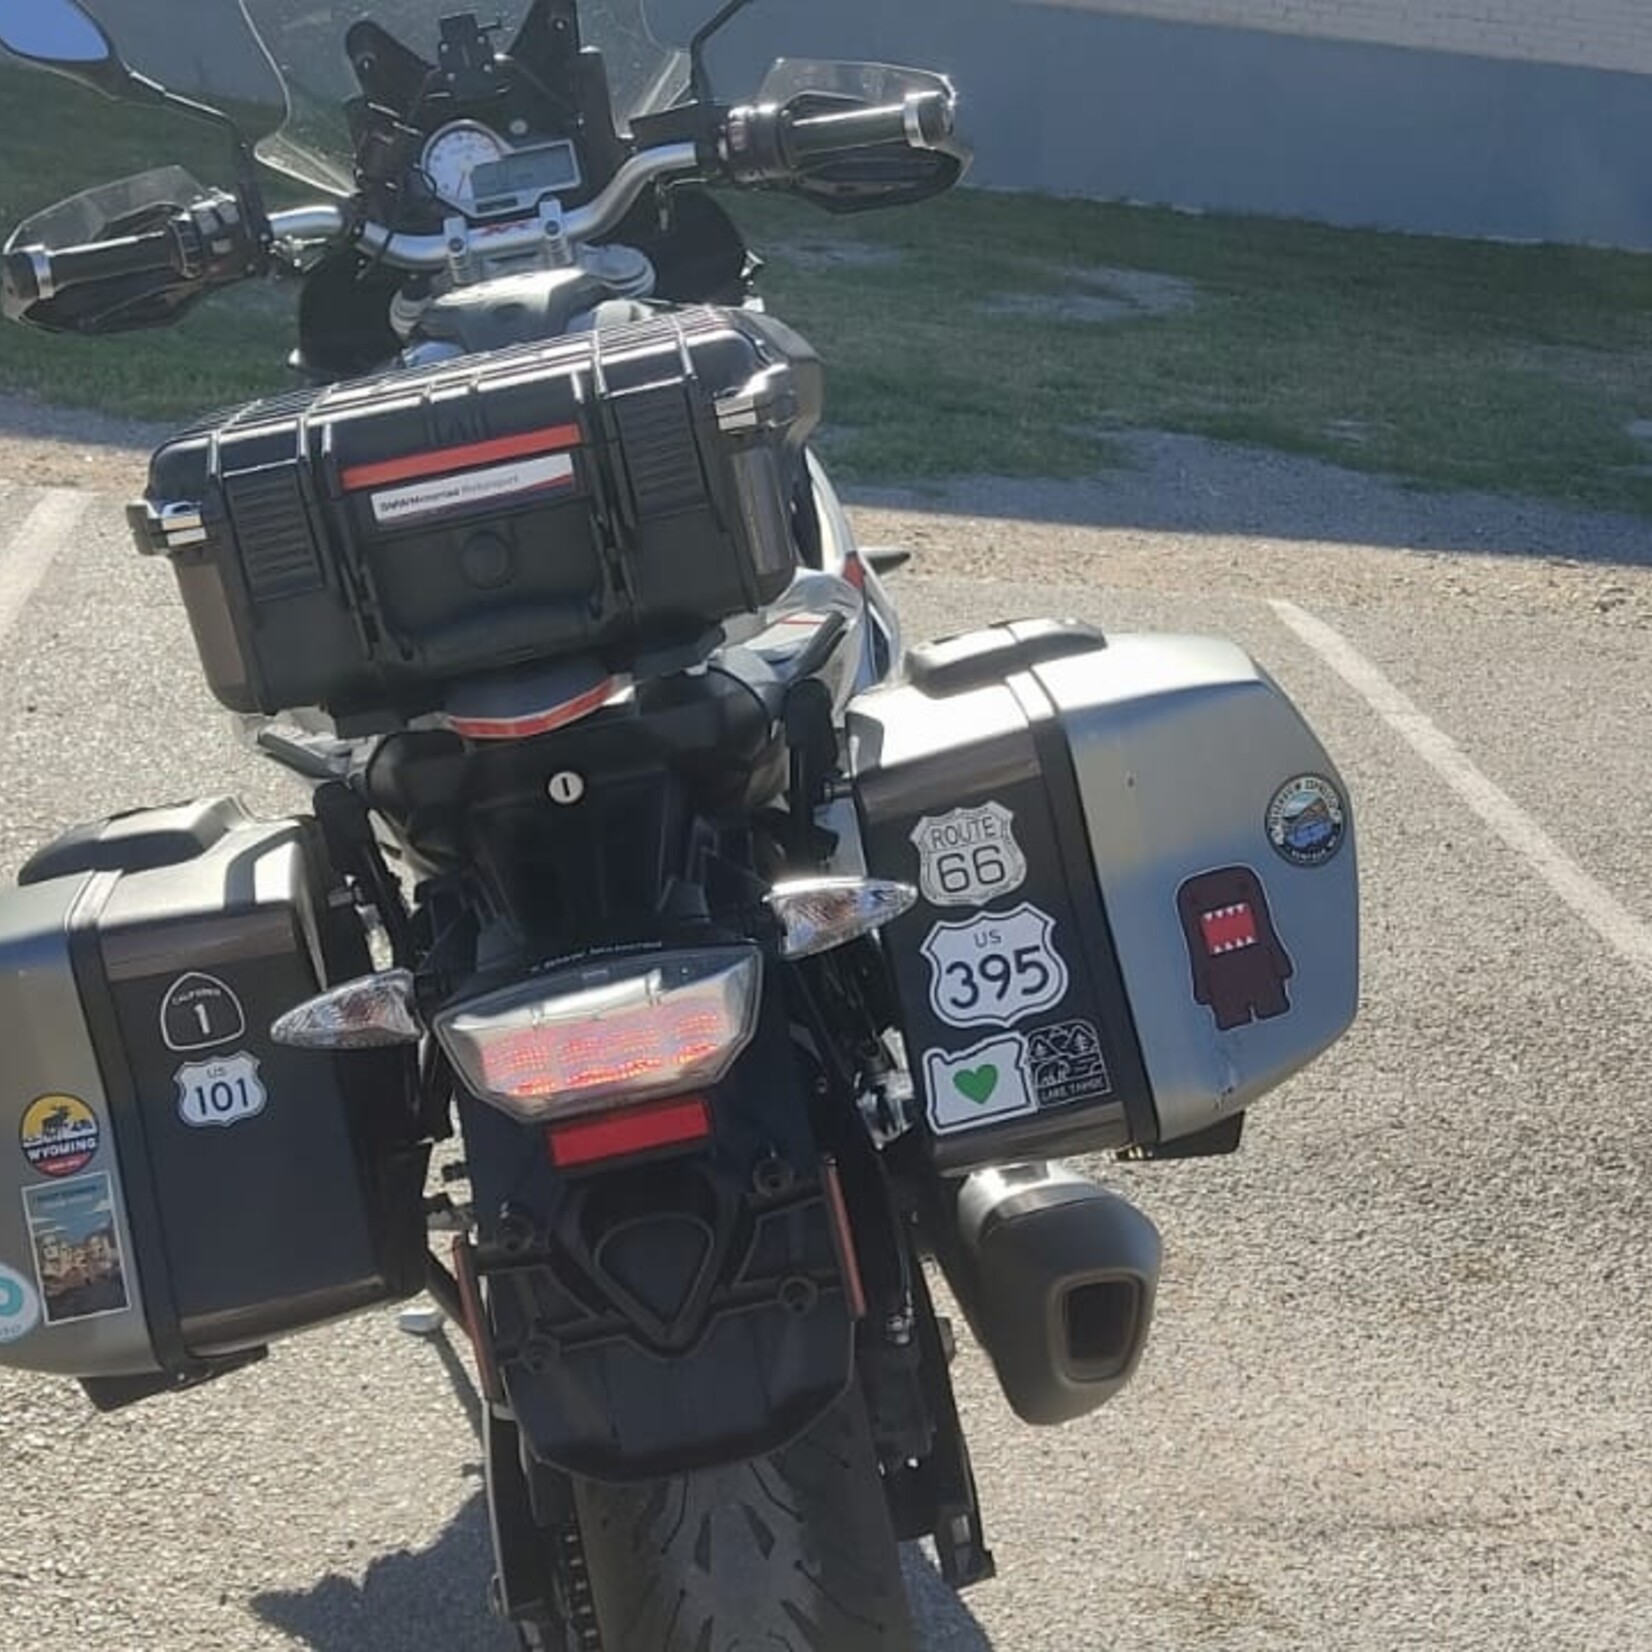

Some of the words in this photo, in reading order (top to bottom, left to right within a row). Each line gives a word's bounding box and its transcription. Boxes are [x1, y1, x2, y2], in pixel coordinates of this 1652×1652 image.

[931, 817, 996, 848] ROUTE
[936, 844, 1006, 894] 66
[973, 929, 1003, 949] US
[944, 945, 1050, 1009] 395
[194, 1003, 211, 1035] 1
[206, 1066, 227, 1079] US
[195, 1079, 249, 1115] 101
[27, 1138, 97, 1161] WYOMING
